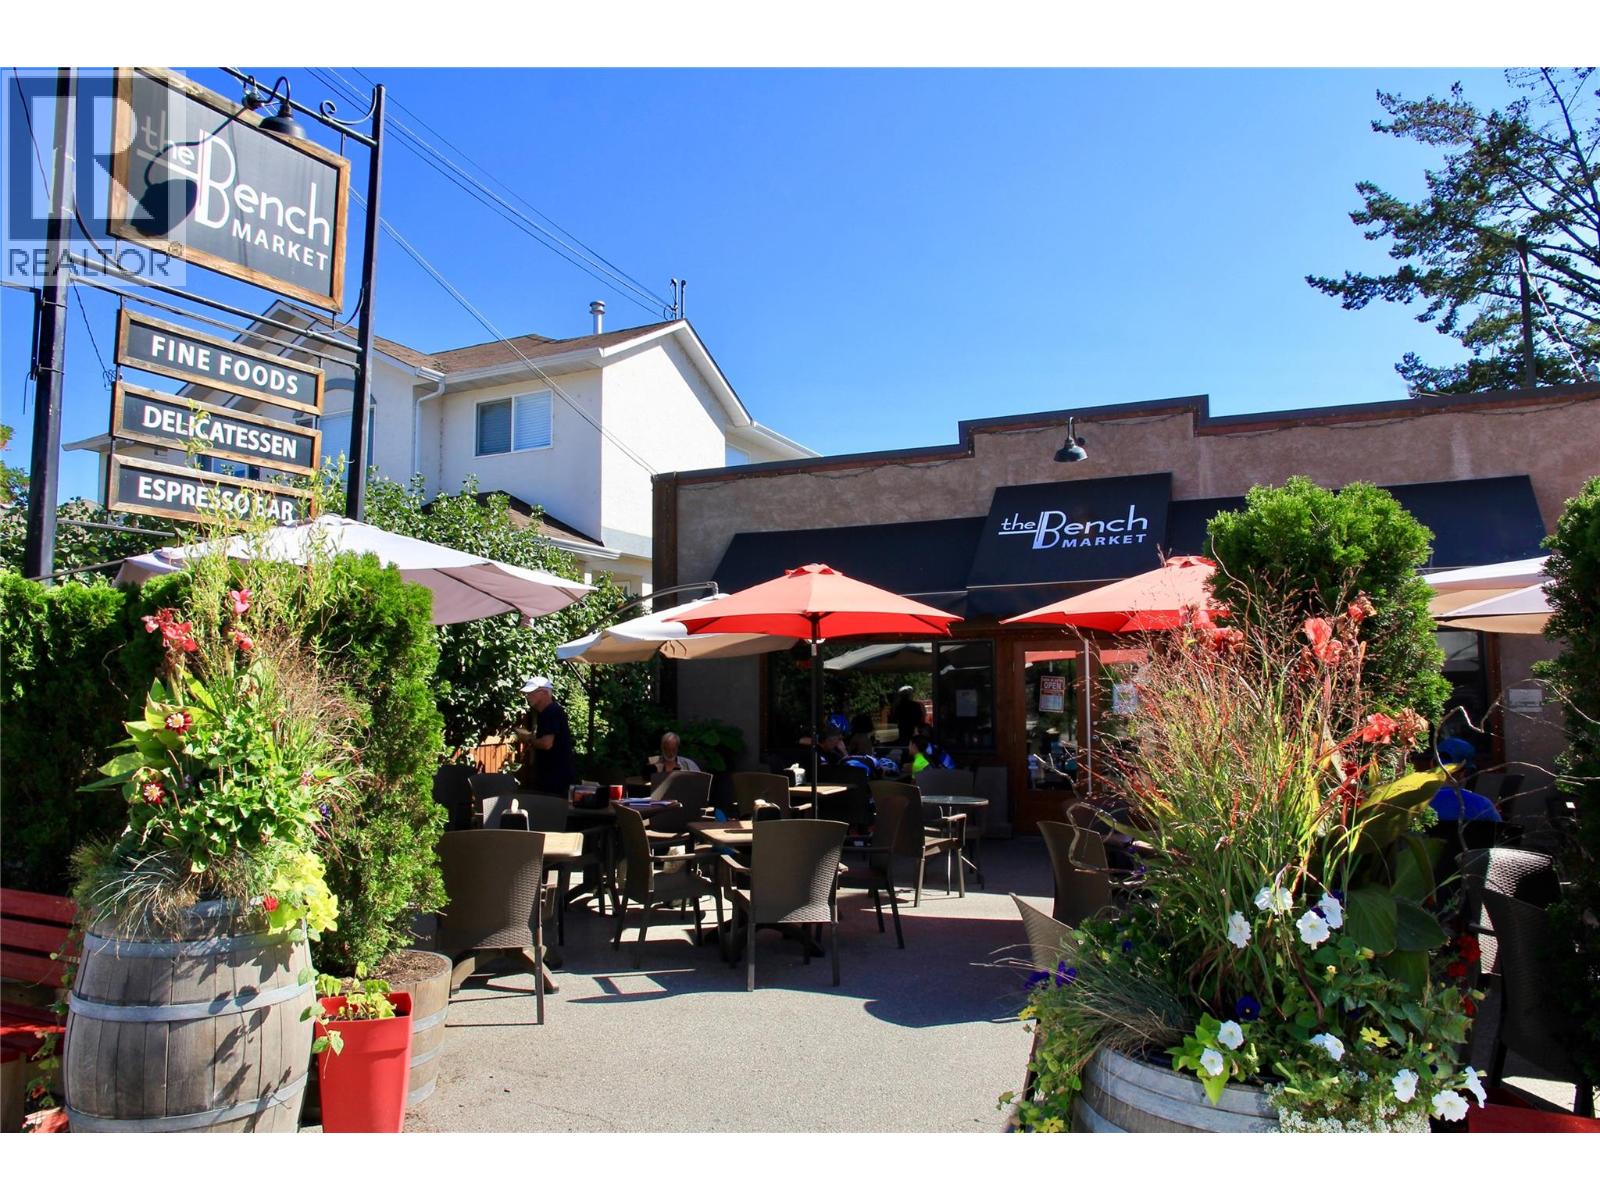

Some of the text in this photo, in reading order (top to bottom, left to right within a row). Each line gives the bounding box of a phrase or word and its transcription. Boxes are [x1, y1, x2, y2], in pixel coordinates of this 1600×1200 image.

[141, 110, 331, 247] the Bench
[231, 219, 329, 272] MARKET
[152, 335, 298, 395] FINE FOODS
[142, 405, 297, 459] DELICATESSEN
[1001, 504, 1148, 550] the Bench
[1061, 533, 1147, 549] MARKET
